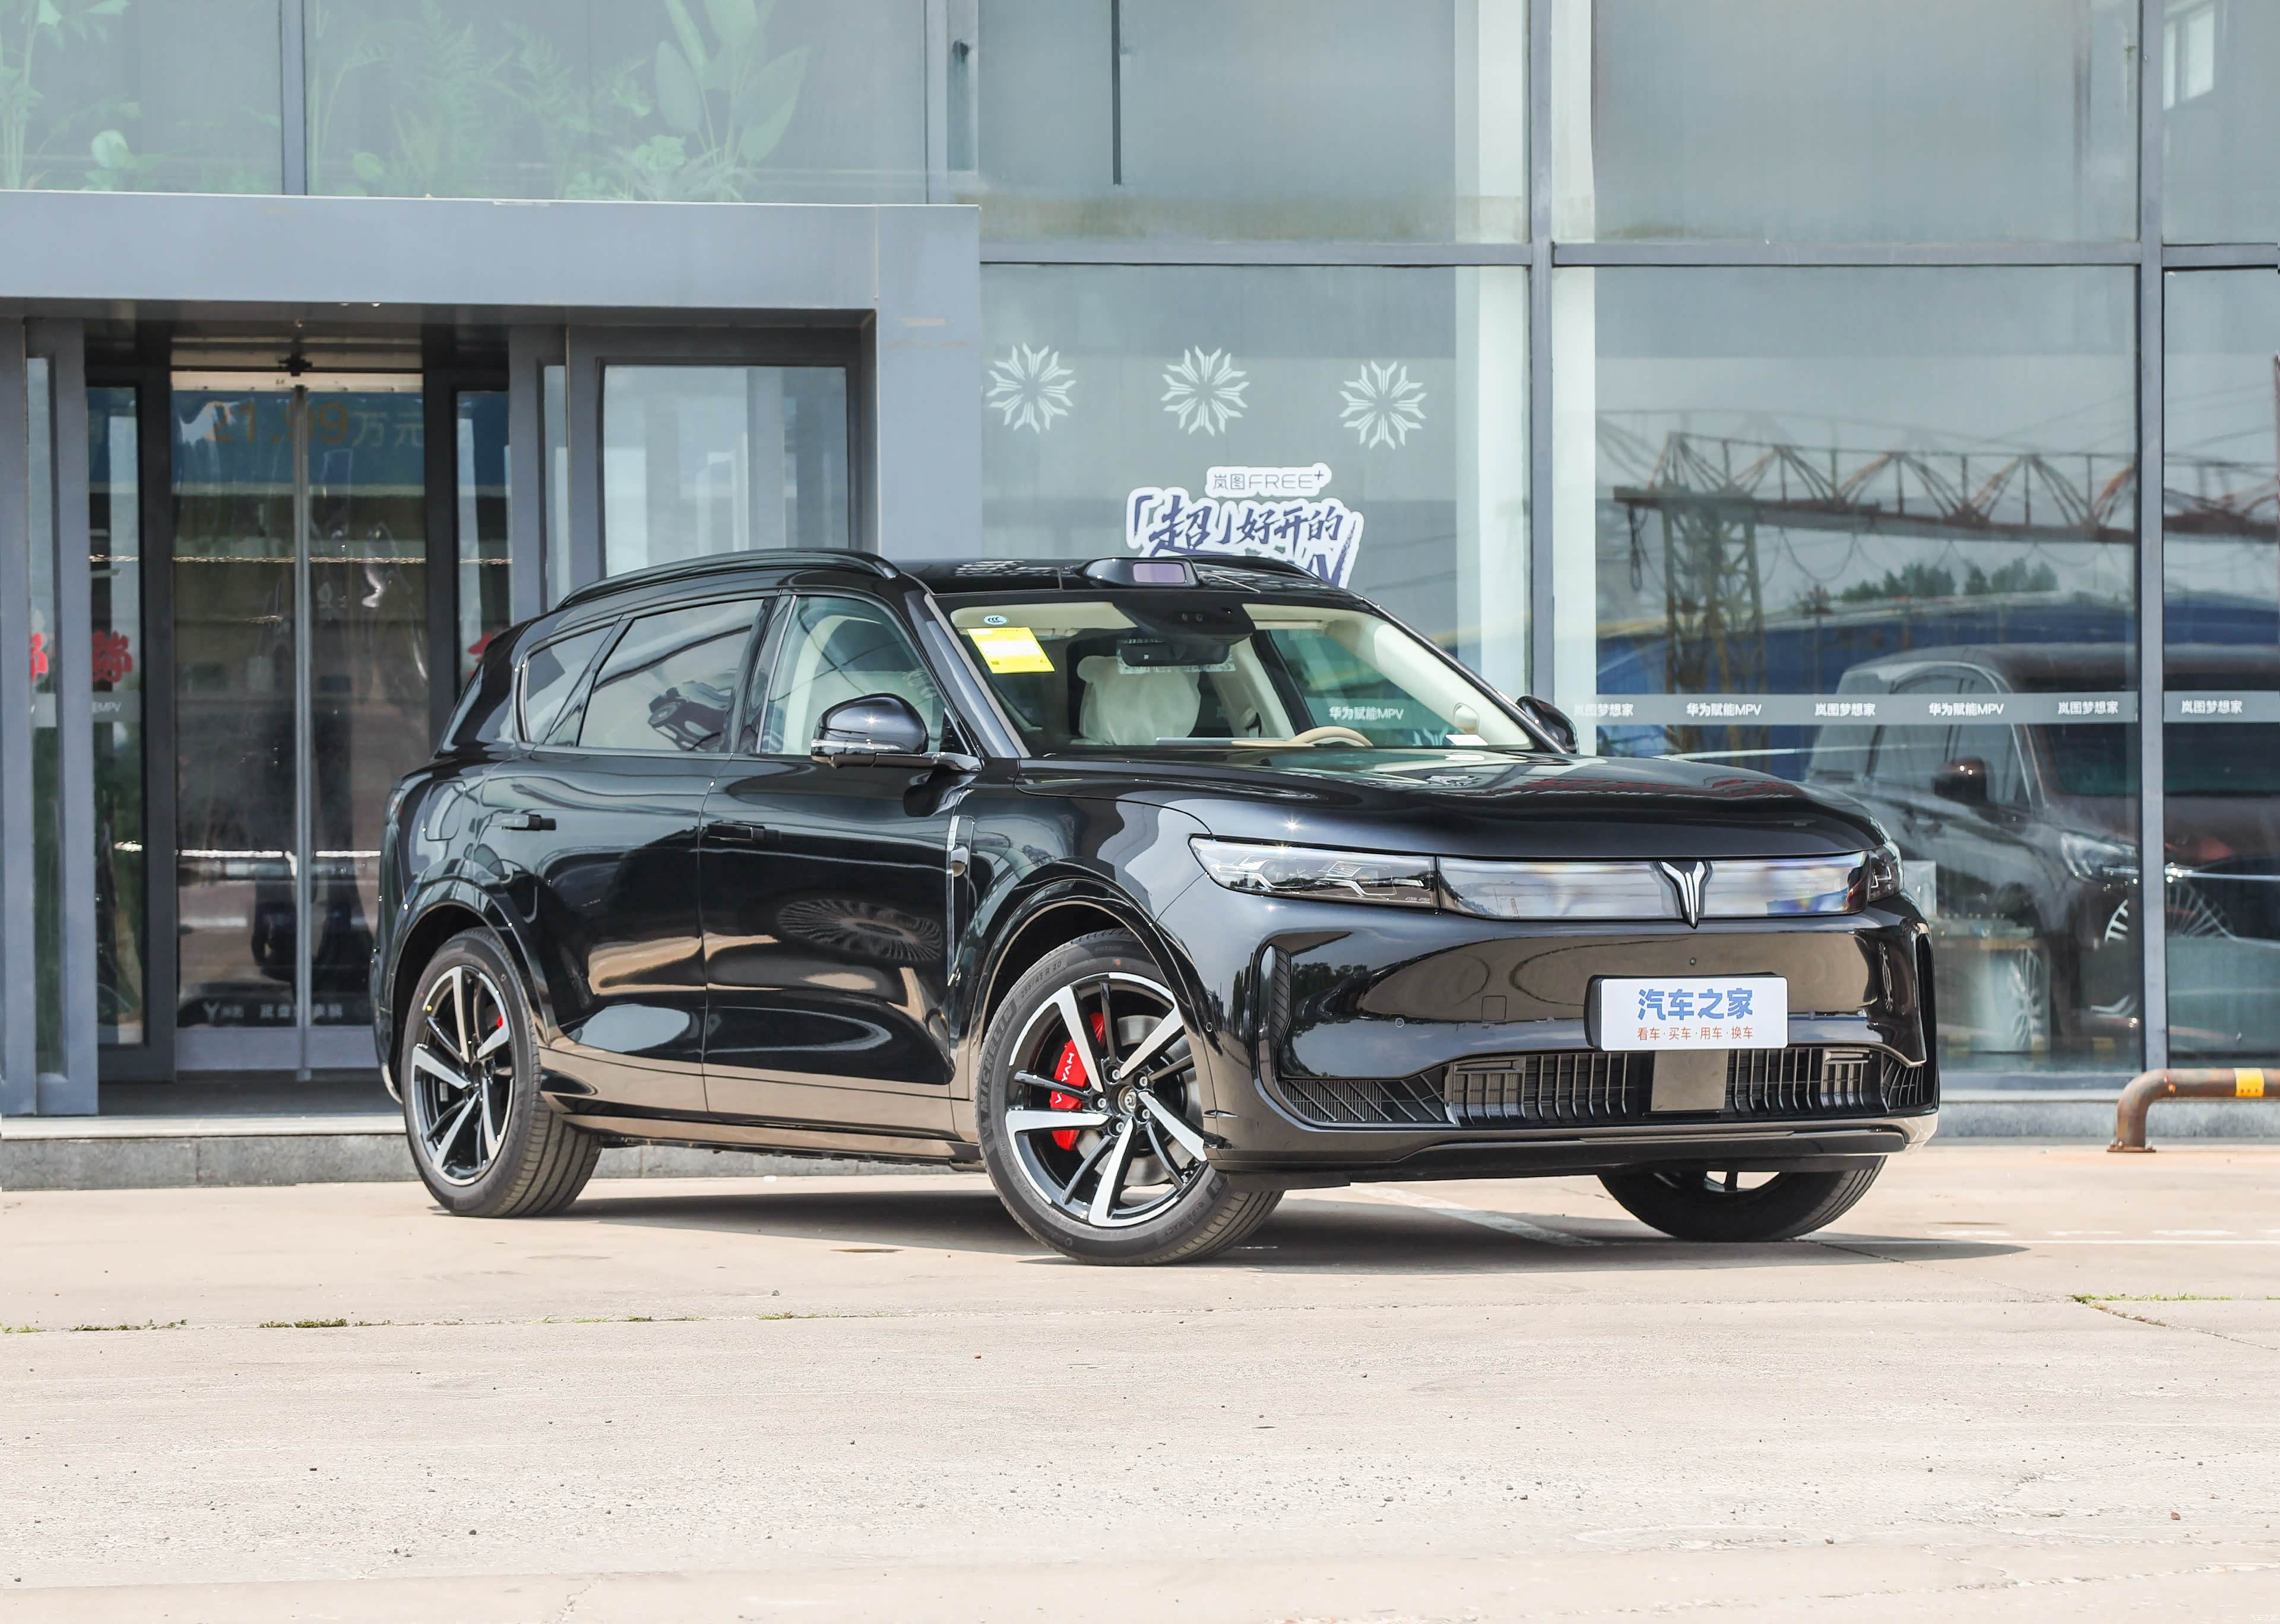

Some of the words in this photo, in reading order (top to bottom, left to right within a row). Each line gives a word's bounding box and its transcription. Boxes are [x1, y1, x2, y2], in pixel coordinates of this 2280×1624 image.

[1329, 706, 1405, 721] 华为赋能MPV
[1686, 702, 1762, 718] 华为赋能MPV
[1814, 702, 1876, 717] 岚图梦想家
[1928, 702, 2004, 717] 华为赋能MPV
[2057, 700, 2118, 715] 岚图梦想家
[2181, 700, 2243, 714] 岚图梦想家
[1637, 987, 1753, 1021] 汽车之家
